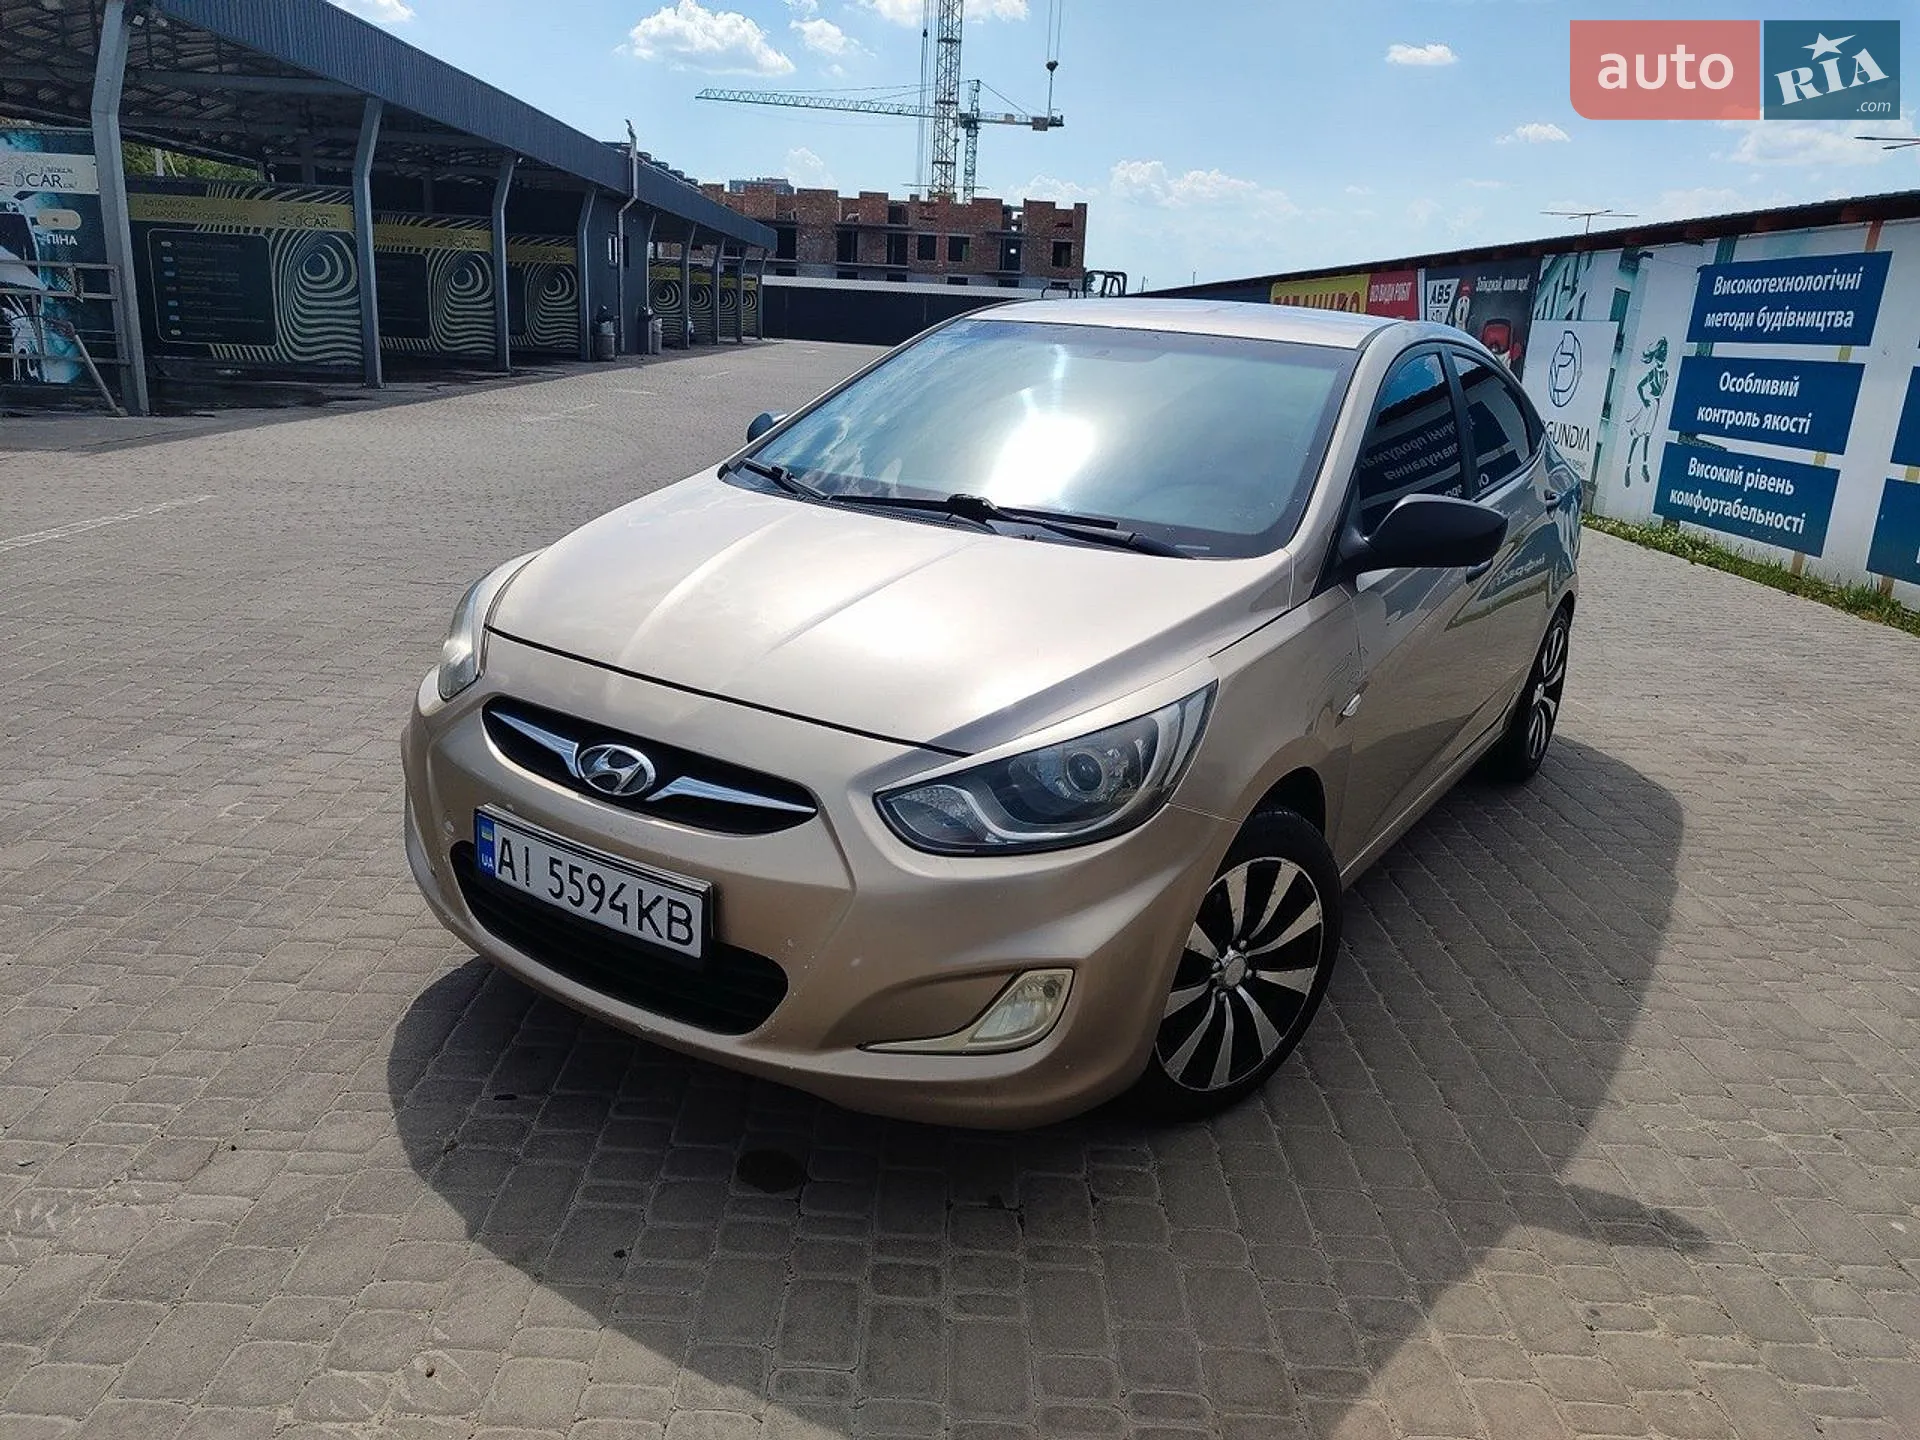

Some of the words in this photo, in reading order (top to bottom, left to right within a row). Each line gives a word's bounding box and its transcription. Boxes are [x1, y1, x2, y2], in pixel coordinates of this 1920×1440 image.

[1429, 283, 1452, 305] ABS
[1713, 267, 1864, 296] Високотехнологічні
[1704, 311, 1753, 330] методи
[1756, 306, 1855, 332] будівництва
[1719, 372, 1800, 398] Особливий
[1696, 405, 1760, 429] контроль
[1762, 412, 1811, 435] якості
[1543, 420, 1590, 452] GUNDIA
[1688, 456, 1743, 487] Високий
[1745, 469, 1795, 496] рівень
[1669, 487, 1806, 535] комфортабельності
[481, 852, 495, 869] UA
[497, 837, 531, 888] AI
